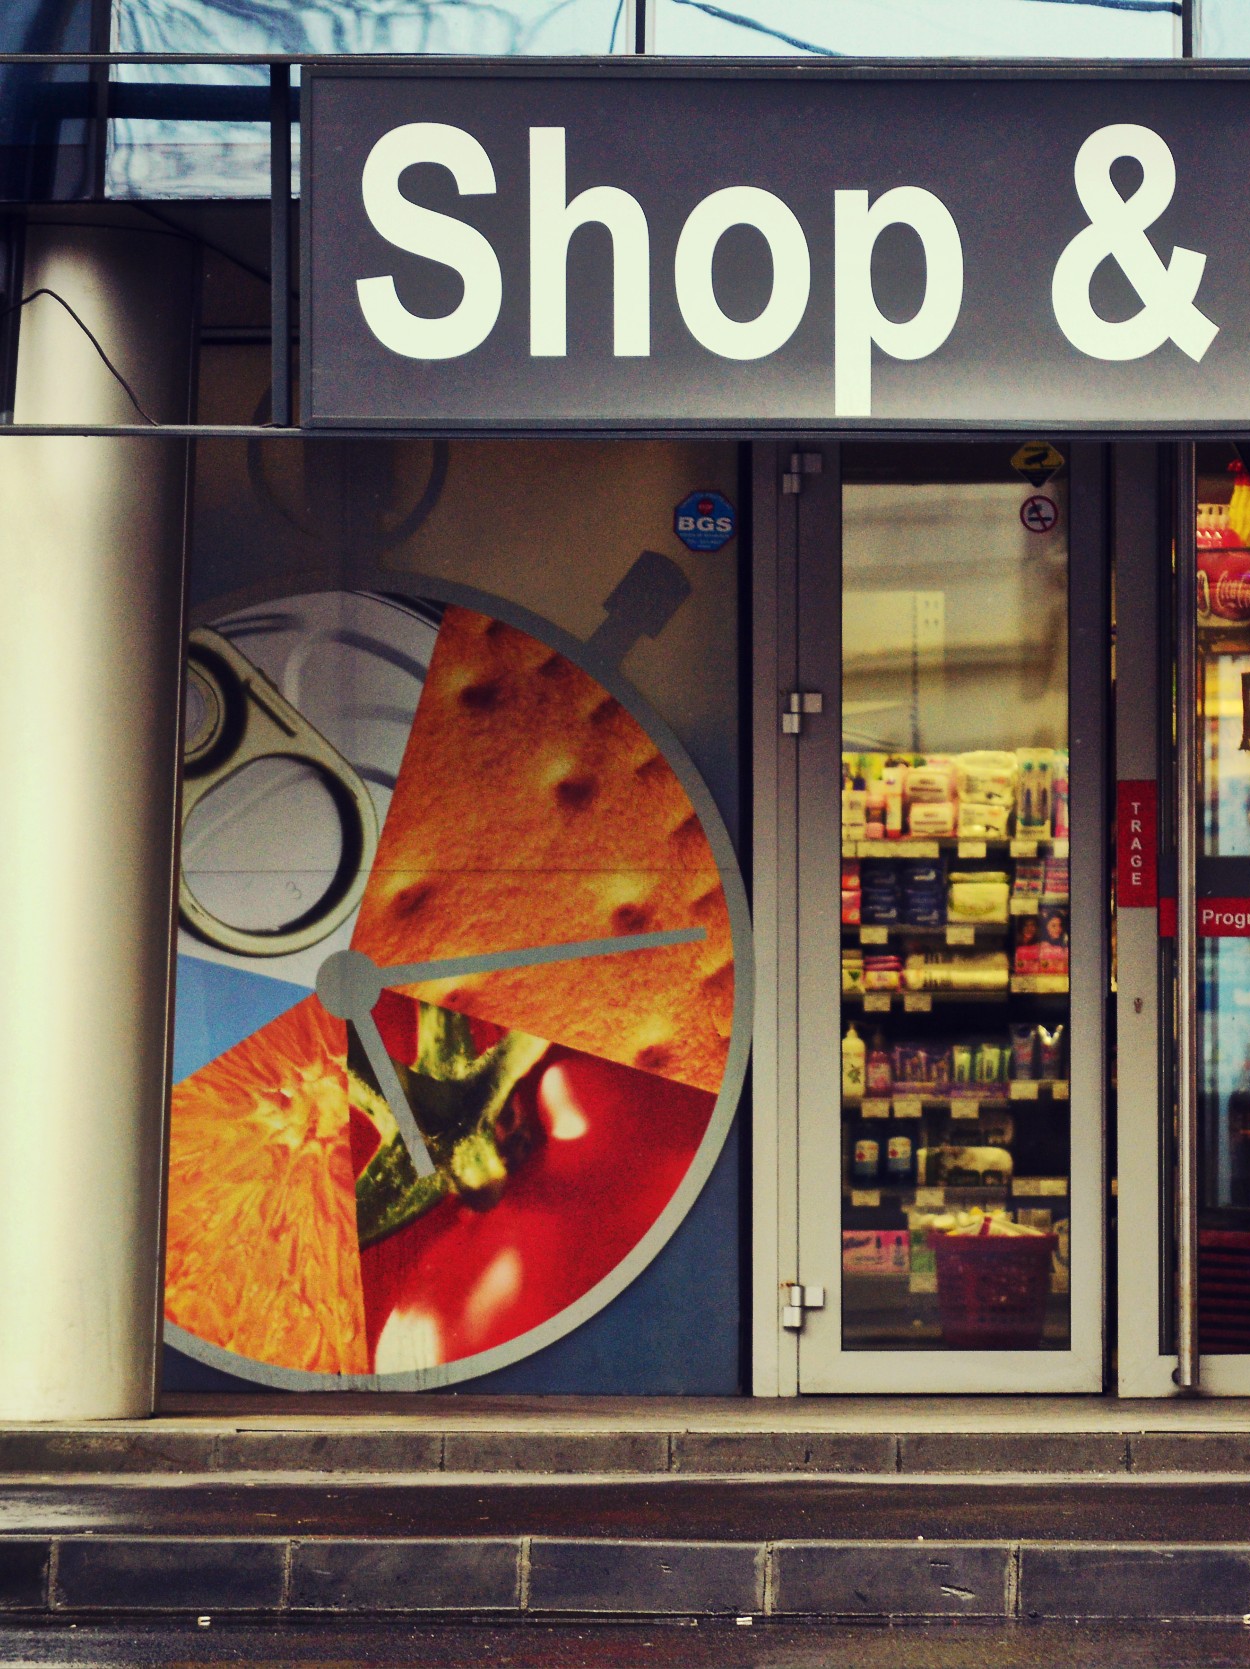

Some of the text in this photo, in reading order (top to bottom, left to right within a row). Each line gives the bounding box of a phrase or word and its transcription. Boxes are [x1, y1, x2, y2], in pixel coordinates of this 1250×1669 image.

[356, 122, 964, 416] Shop
[1051, 123, 1220, 363] &
[678, 516, 732, 532] BGS
[1130, 802, 1142, 885] TRAGE
